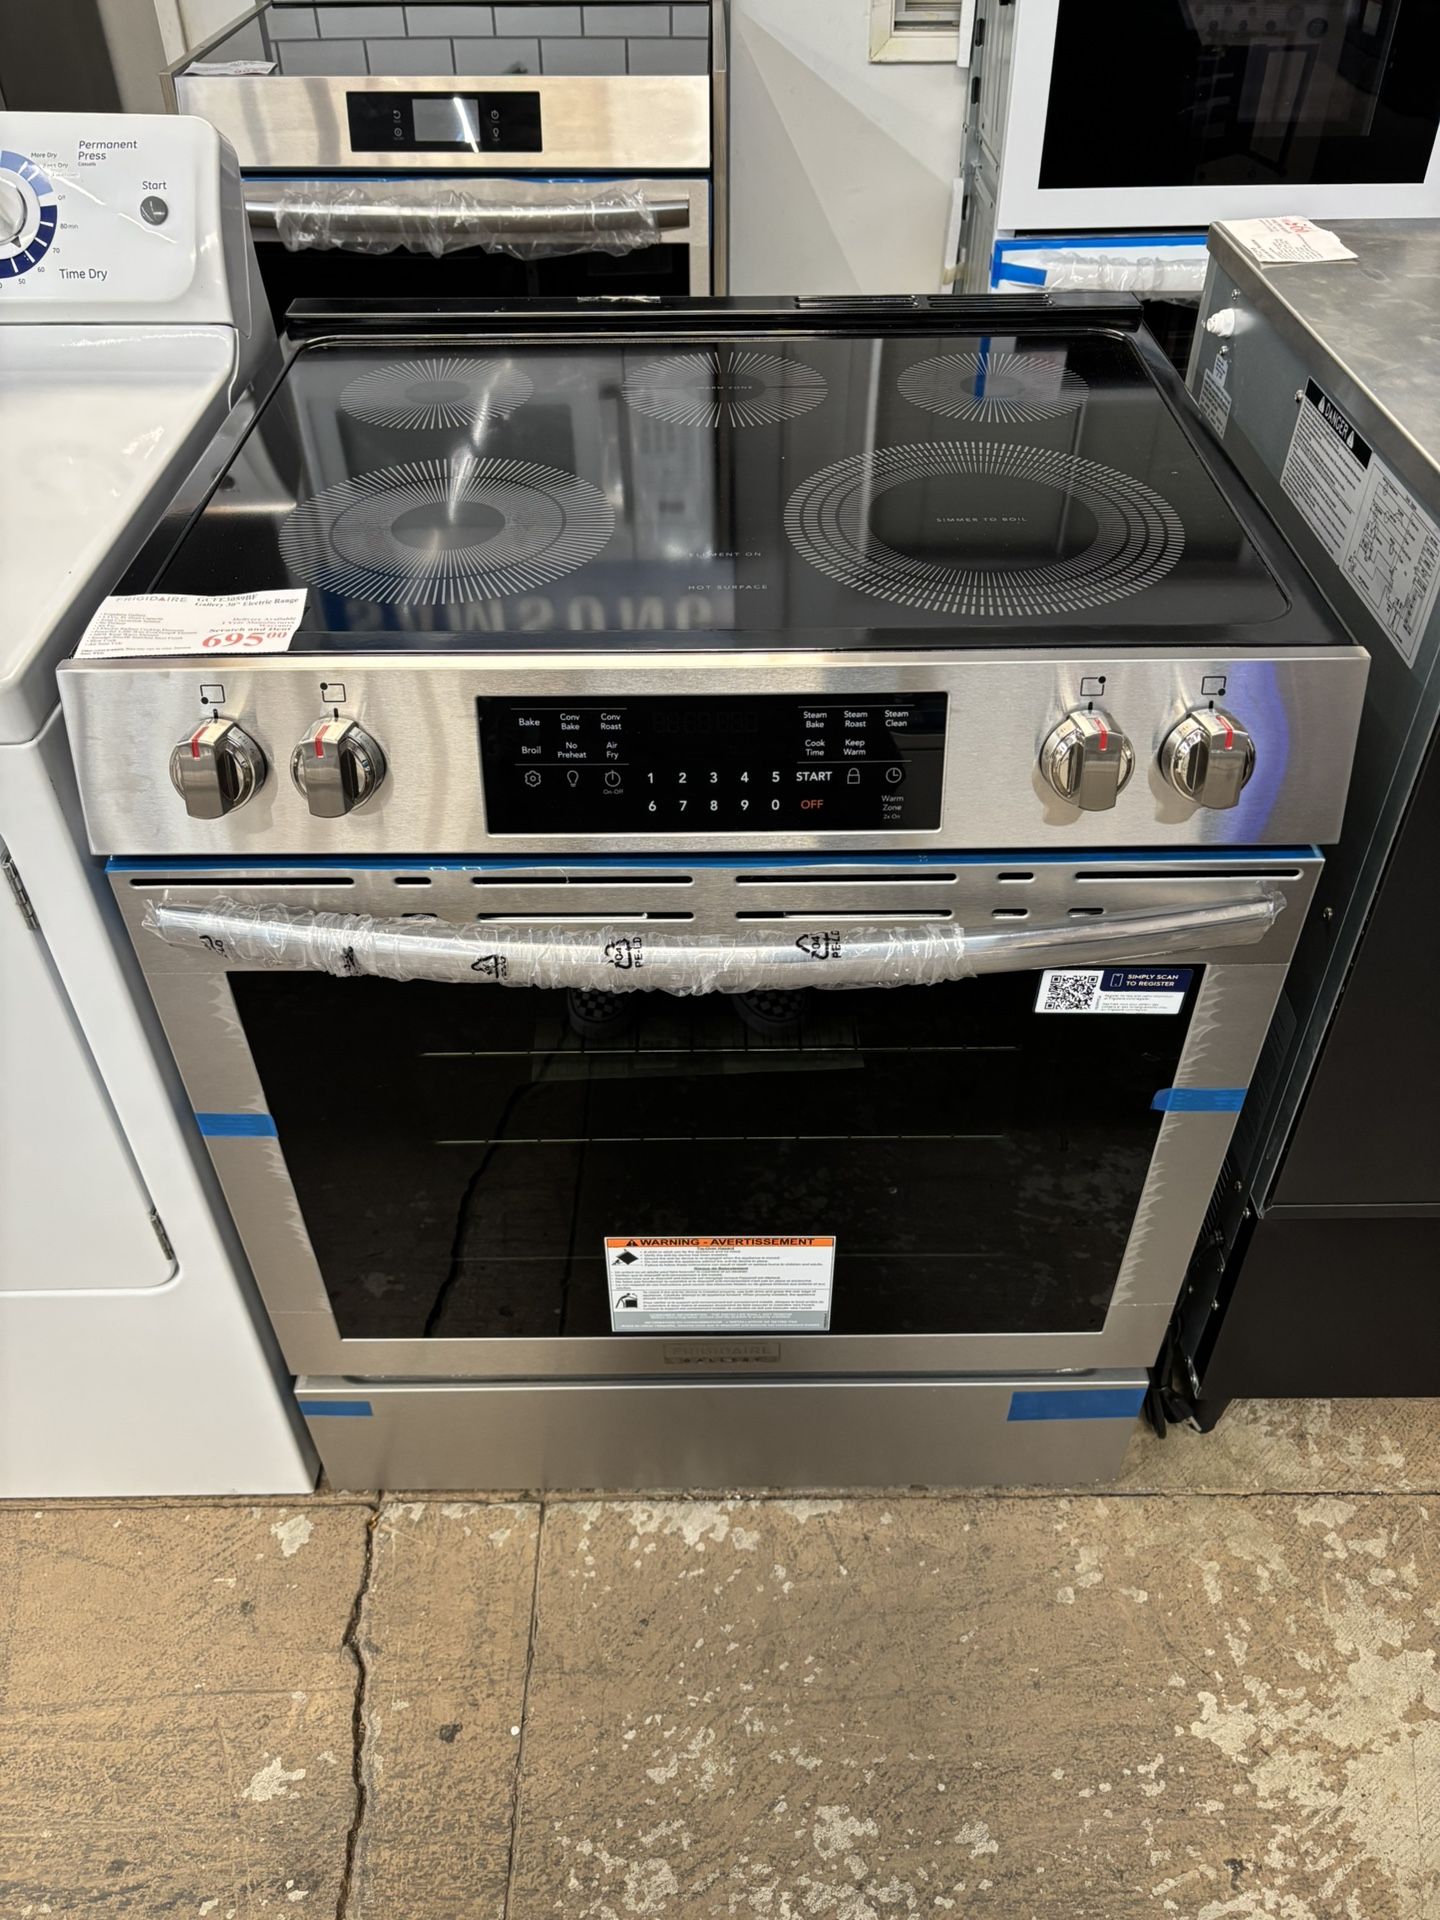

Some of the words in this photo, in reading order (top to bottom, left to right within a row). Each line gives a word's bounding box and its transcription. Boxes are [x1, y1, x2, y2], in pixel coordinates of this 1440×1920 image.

[79, 140, 138, 150] Permanent
[78, 151, 107, 161] Press
[142, 180, 168, 191] Start
[59, 268, 86, 280] Time
[88, 268, 109, 281] Dry
[18, 278, 26, 286] 50
[1322, 401, 1350, 438] DANGER
[716, 583, 769, 591] SURFACE
[242, 598, 273, 606] Electric
[559, 713, 581, 721] Conv
[600, 713, 621, 721] Conv
[803, 711, 827, 719] Steam
[843, 710, 868, 718] Steam
[884, 709, 909, 718] Steam
[518, 718, 541, 727] Bake
[560, 722, 580, 730] Bake
[600, 722, 622, 730] Roast
[805, 720, 825, 728] Bake
[844, 720, 867, 728] Roast
[885, 719, 908, 727] Clean
[804, 739, 826, 747] Cook
[845, 739, 866, 748] Keep
[521, 746, 542, 755] Broil
[557, 751, 587, 759] Preheat
[805, 748, 825, 756] Time
[843, 748, 867, 756] Warm
[606, 751, 619, 760] Fry
[647, 772, 654, 784] 1
[678, 772, 687, 784] 2
[709, 771, 718, 783] 3
[740, 771, 749, 783] 4
[771, 771, 780, 783] 5
[796, 771, 833, 782] START
[648, 800, 657, 812] 6
[679, 800, 687, 811] 7
[709, 800, 718, 811] 8
[740, 799, 749, 811] 9
[771, 799, 780, 811] 0
[800, 799, 824, 810] OFF
[812, 934, 821, 949] 04
[831, 930, 842, 959] PE-LD
[614, 947, 624, 963] 04
[634, 936, 642, 968] PE-LD
[640, 1238, 700, 1246] WARNING
[710, 1238, 816, 1246] AVERTISSEMENT
